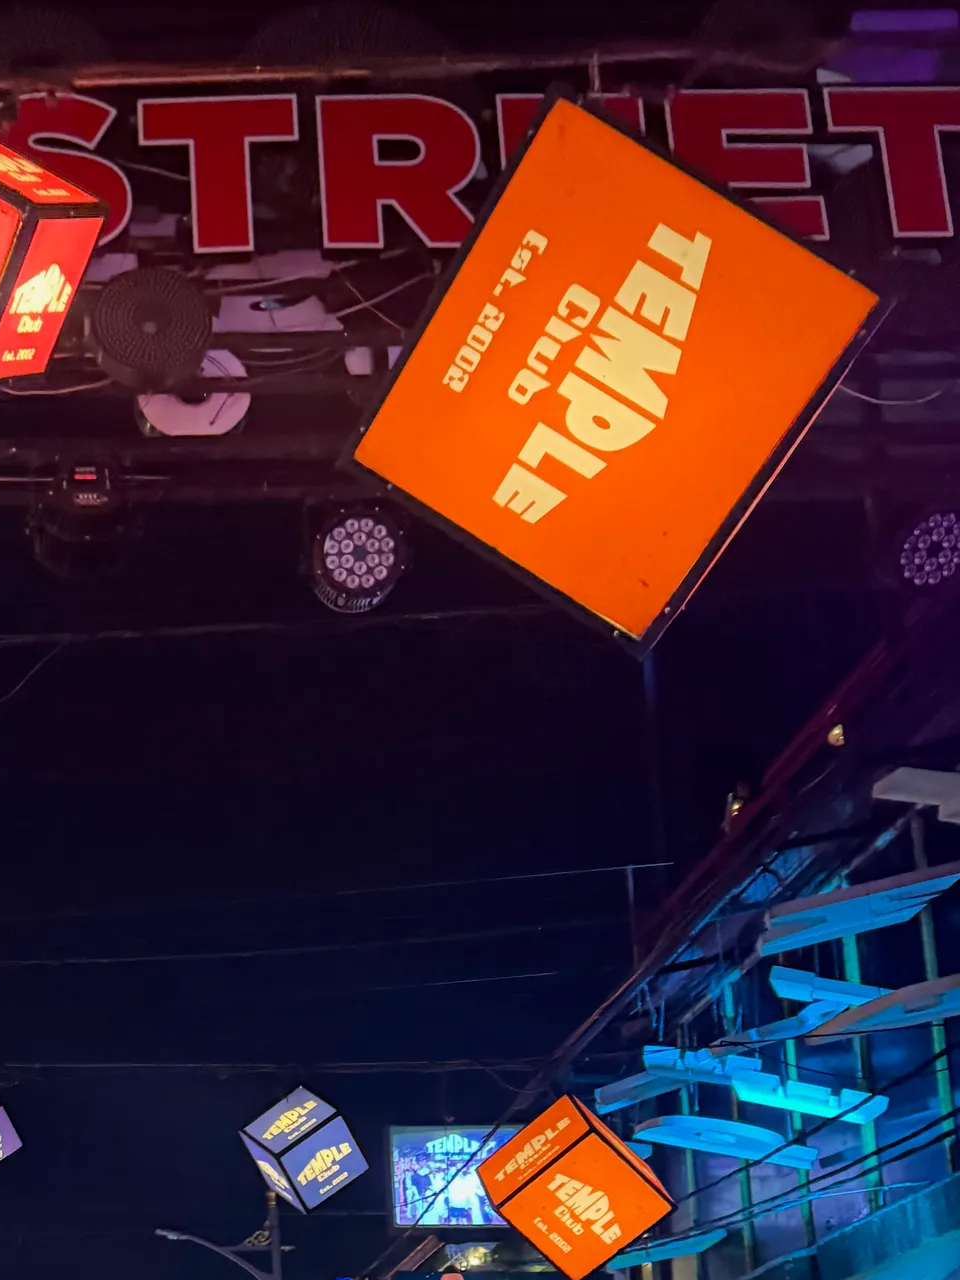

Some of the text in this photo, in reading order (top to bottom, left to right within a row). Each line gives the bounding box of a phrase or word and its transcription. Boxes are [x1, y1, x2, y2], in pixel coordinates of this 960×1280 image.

[9, 262, 73, 316] TEMPLE
[441, 229, 549, 394] Est. 2002
[17, 315, 44, 334] Club
[507, 282, 602, 406] Club
[492, 221, 713, 525] TEMPLE
[262, 1100, 318, 1140] TEMPLE
[493, 1116, 572, 1183] TEMPLE
[296, 1141, 353, 1187] TEMPLE
[546, 1172, 623, 1245] TEMPLE
[553, 1204, 585, 1236] Club
